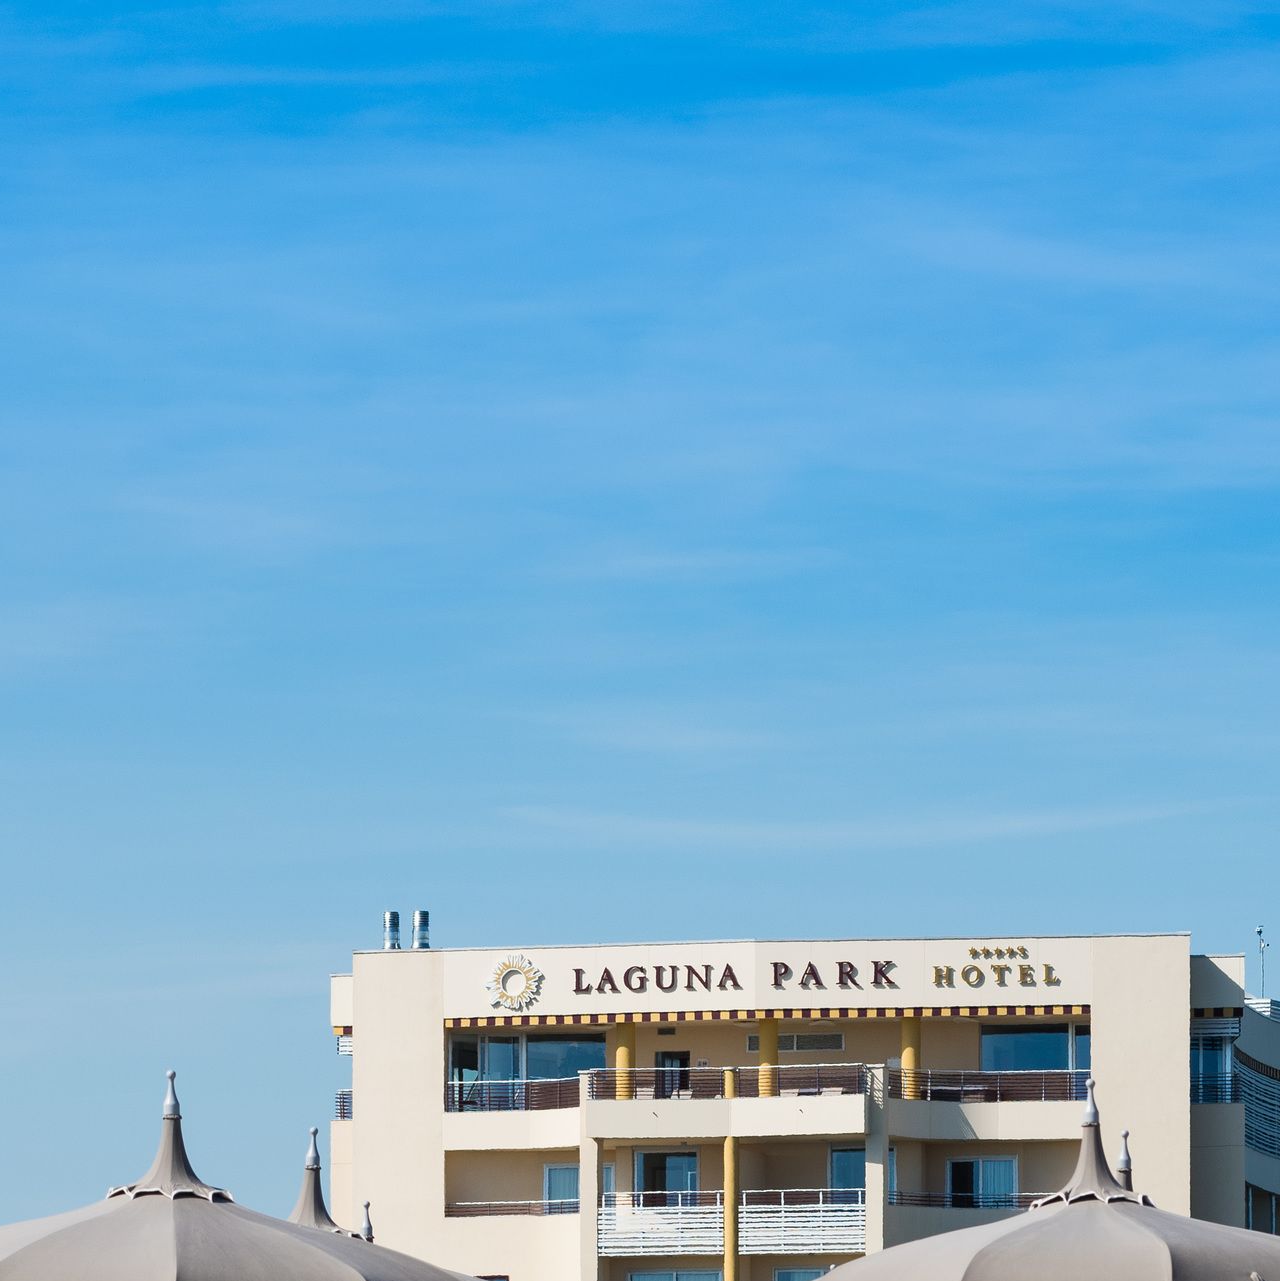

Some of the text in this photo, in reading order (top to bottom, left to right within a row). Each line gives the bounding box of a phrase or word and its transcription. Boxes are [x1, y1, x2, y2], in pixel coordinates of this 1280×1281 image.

[572, 960, 1060, 995] LAGUNA PARK HOTEL
